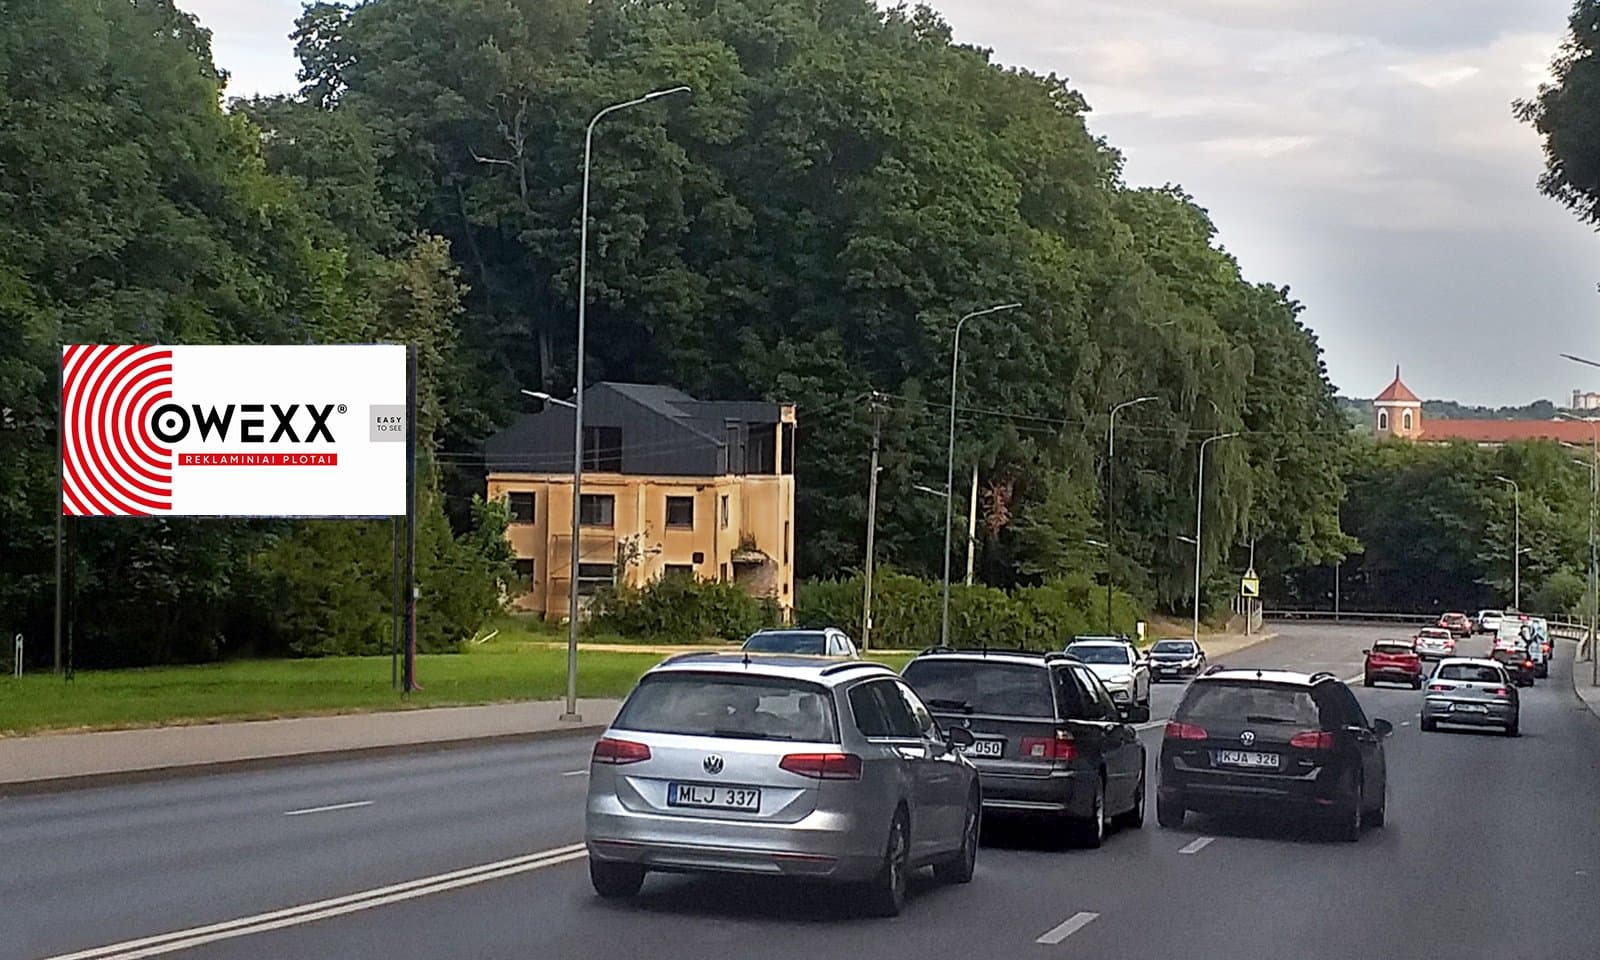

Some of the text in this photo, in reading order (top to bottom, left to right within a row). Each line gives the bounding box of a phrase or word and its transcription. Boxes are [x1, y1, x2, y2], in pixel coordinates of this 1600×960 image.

[376, 416, 402, 424] EASY
[376, 424, 402, 432] TO SEE
[185, 455, 332, 465] REKLAMINIAI PLOTAI
[976, 741, 1000, 754] 050
[1223, 751, 1277, 765] KJA 326
[680, 786, 757, 806] MLJ 337
